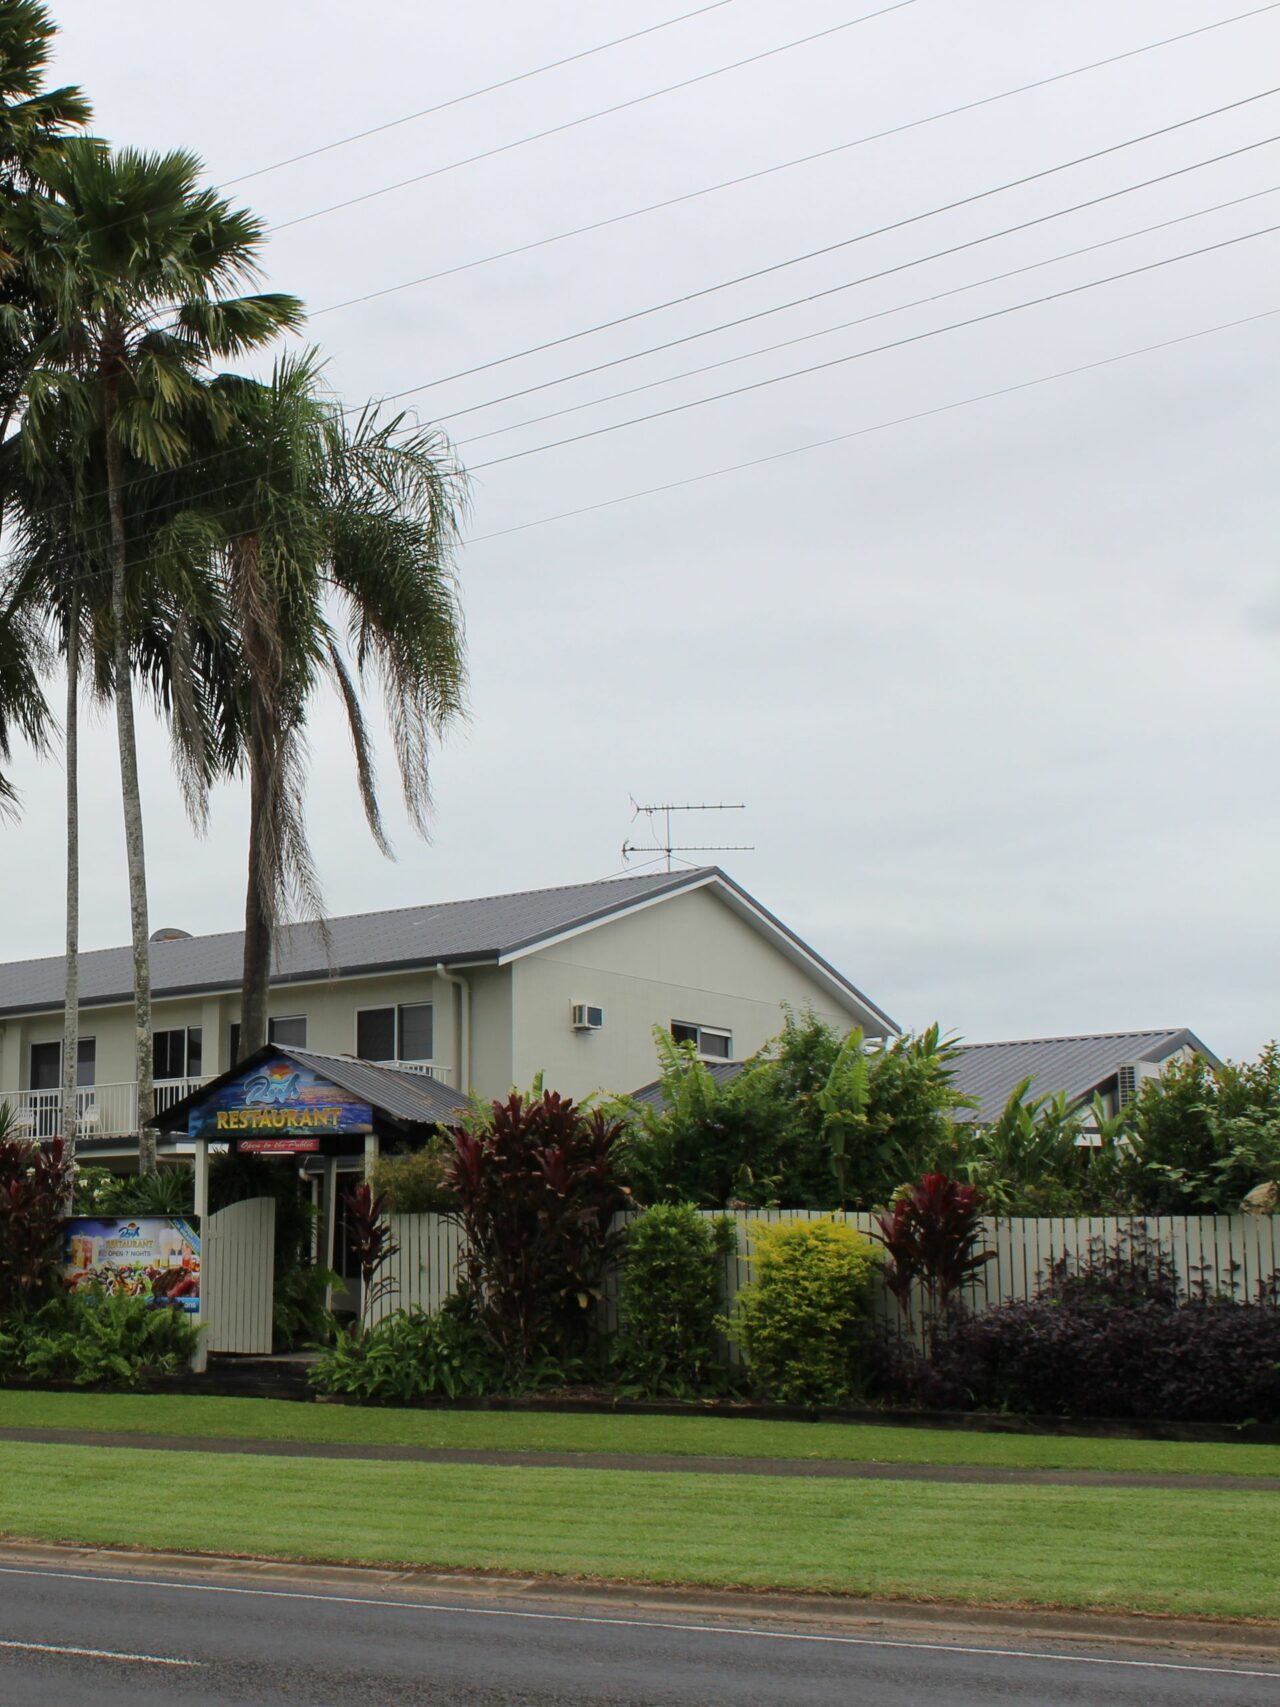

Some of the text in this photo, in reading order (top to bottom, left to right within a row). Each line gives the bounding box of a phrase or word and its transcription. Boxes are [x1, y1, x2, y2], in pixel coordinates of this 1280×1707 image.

[217, 1107, 342, 1129] RESTAURANT
[241, 1141, 260, 1150] Open
[274, 1140, 285, 1148] the
[105, 1239, 153, 1248] RESTAURANT
